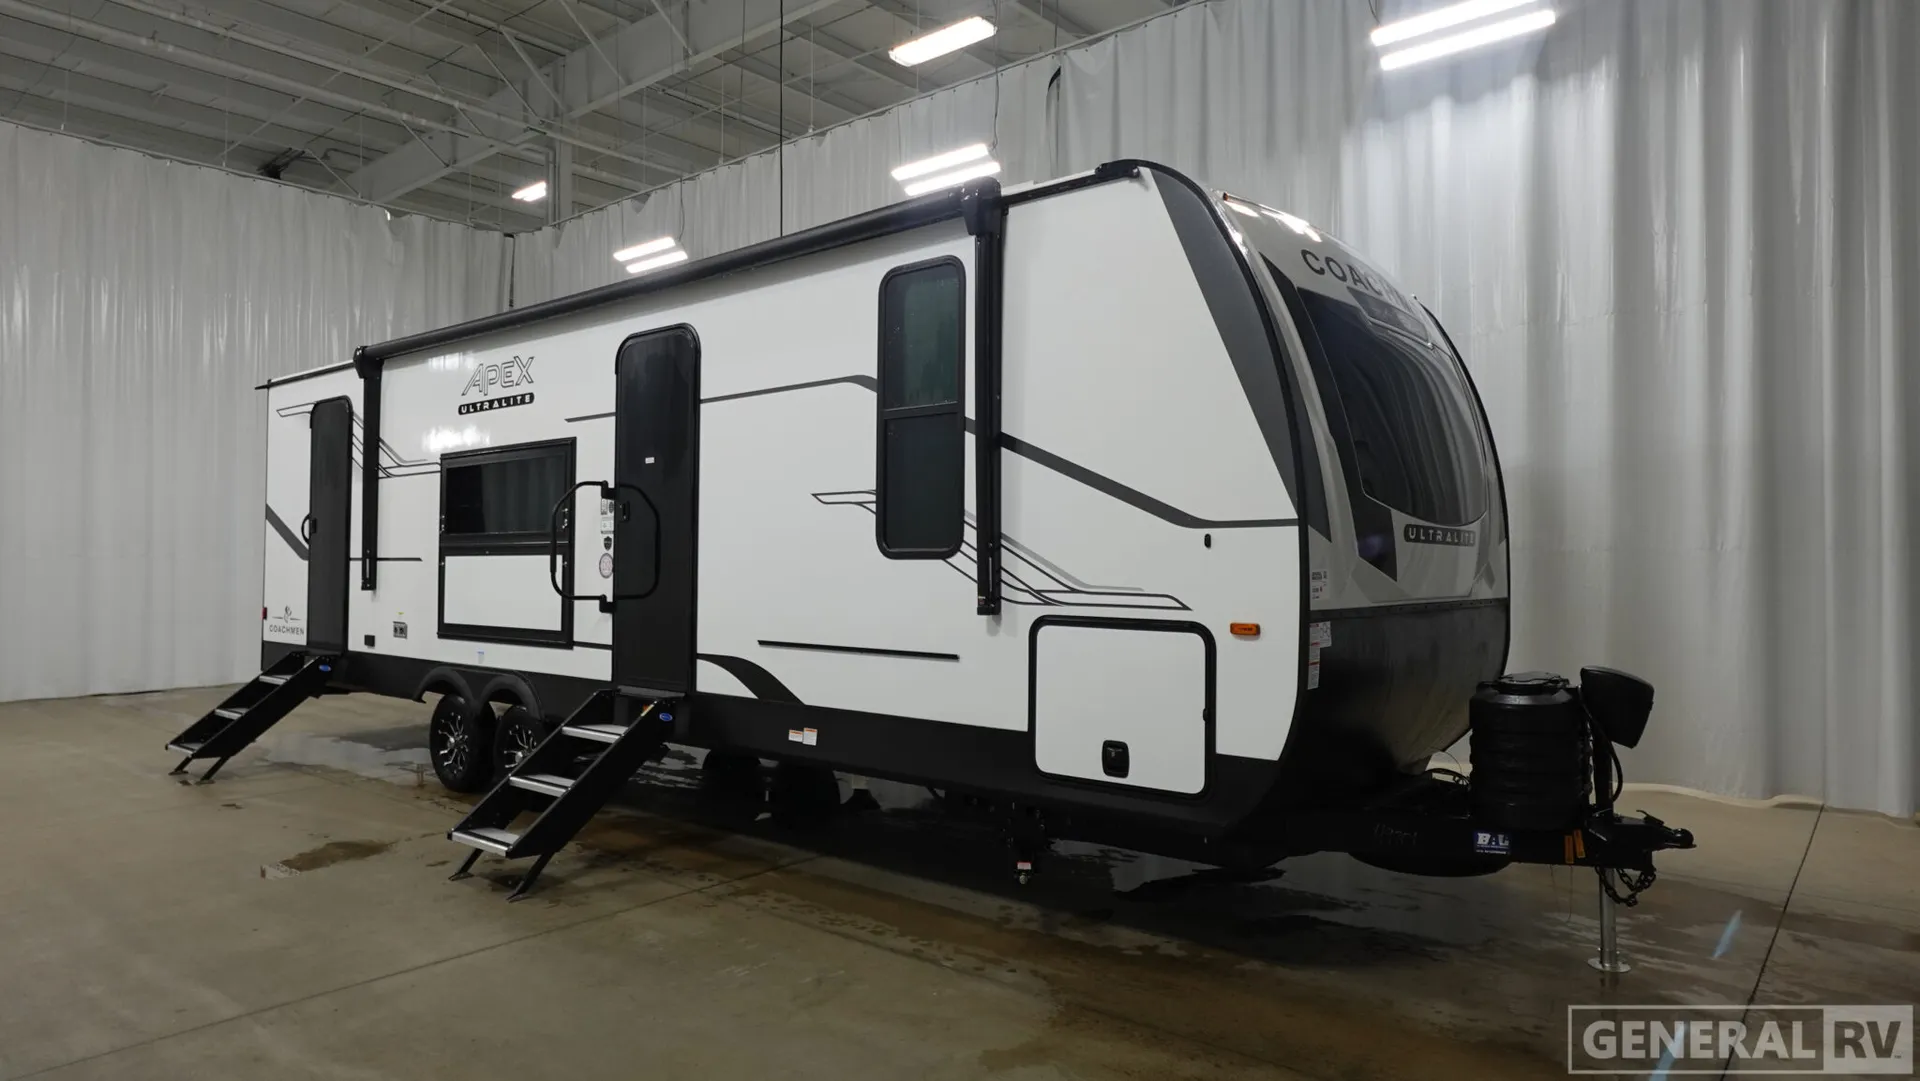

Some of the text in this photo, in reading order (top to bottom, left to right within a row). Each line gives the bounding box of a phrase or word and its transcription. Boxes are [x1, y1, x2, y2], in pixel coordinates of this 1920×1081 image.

[461, 355, 535, 397] APEX
[461, 394, 532, 414] ULTRALITE
[1409, 527, 1474, 545] ULTRALITE
[269, 624, 305, 636] COACHMEN
